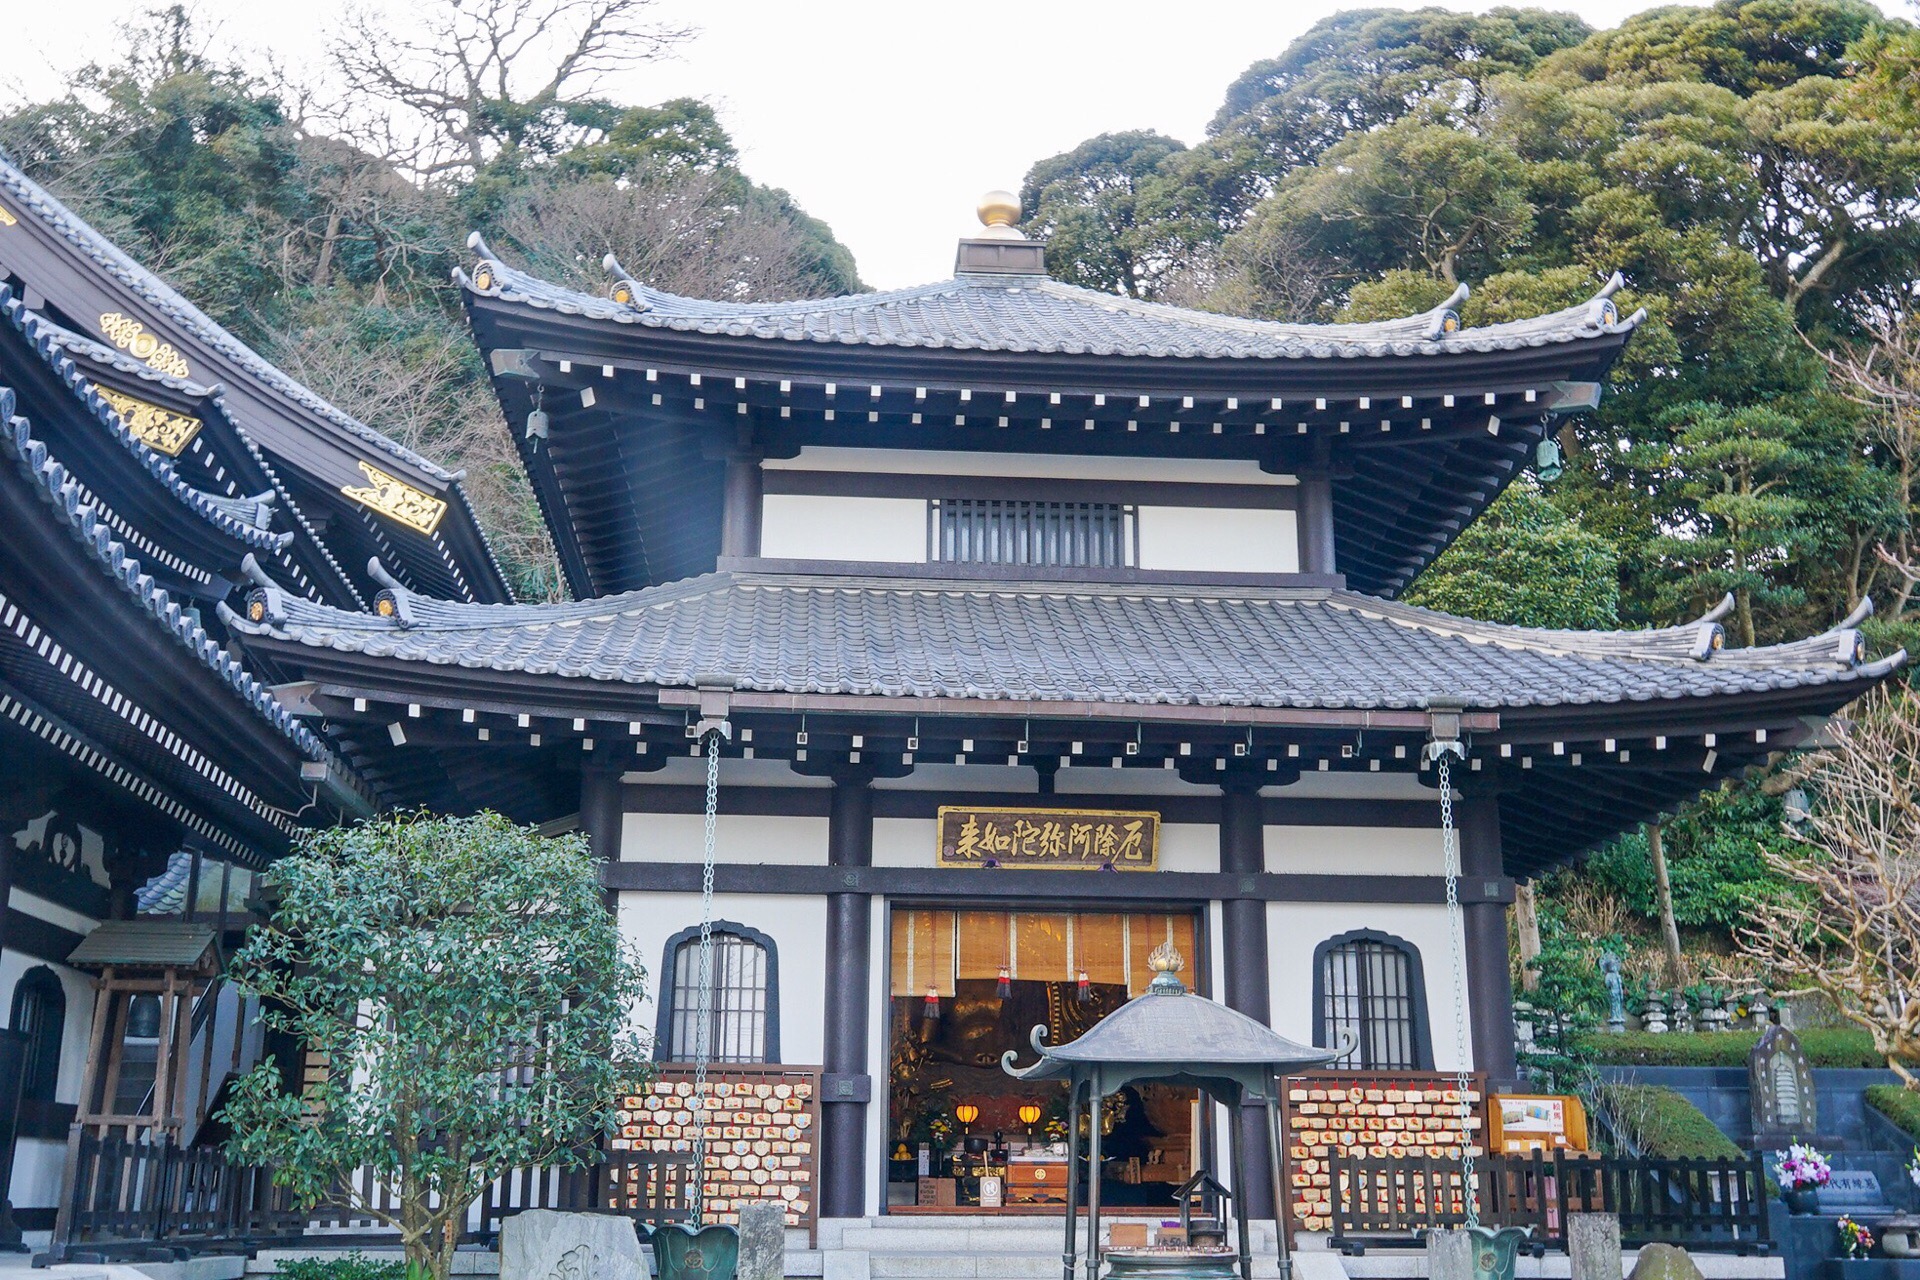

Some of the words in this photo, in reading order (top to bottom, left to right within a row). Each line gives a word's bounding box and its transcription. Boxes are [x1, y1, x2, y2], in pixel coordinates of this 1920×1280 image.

[955, 814, 1144, 864] 厄除阿弥陀如来
